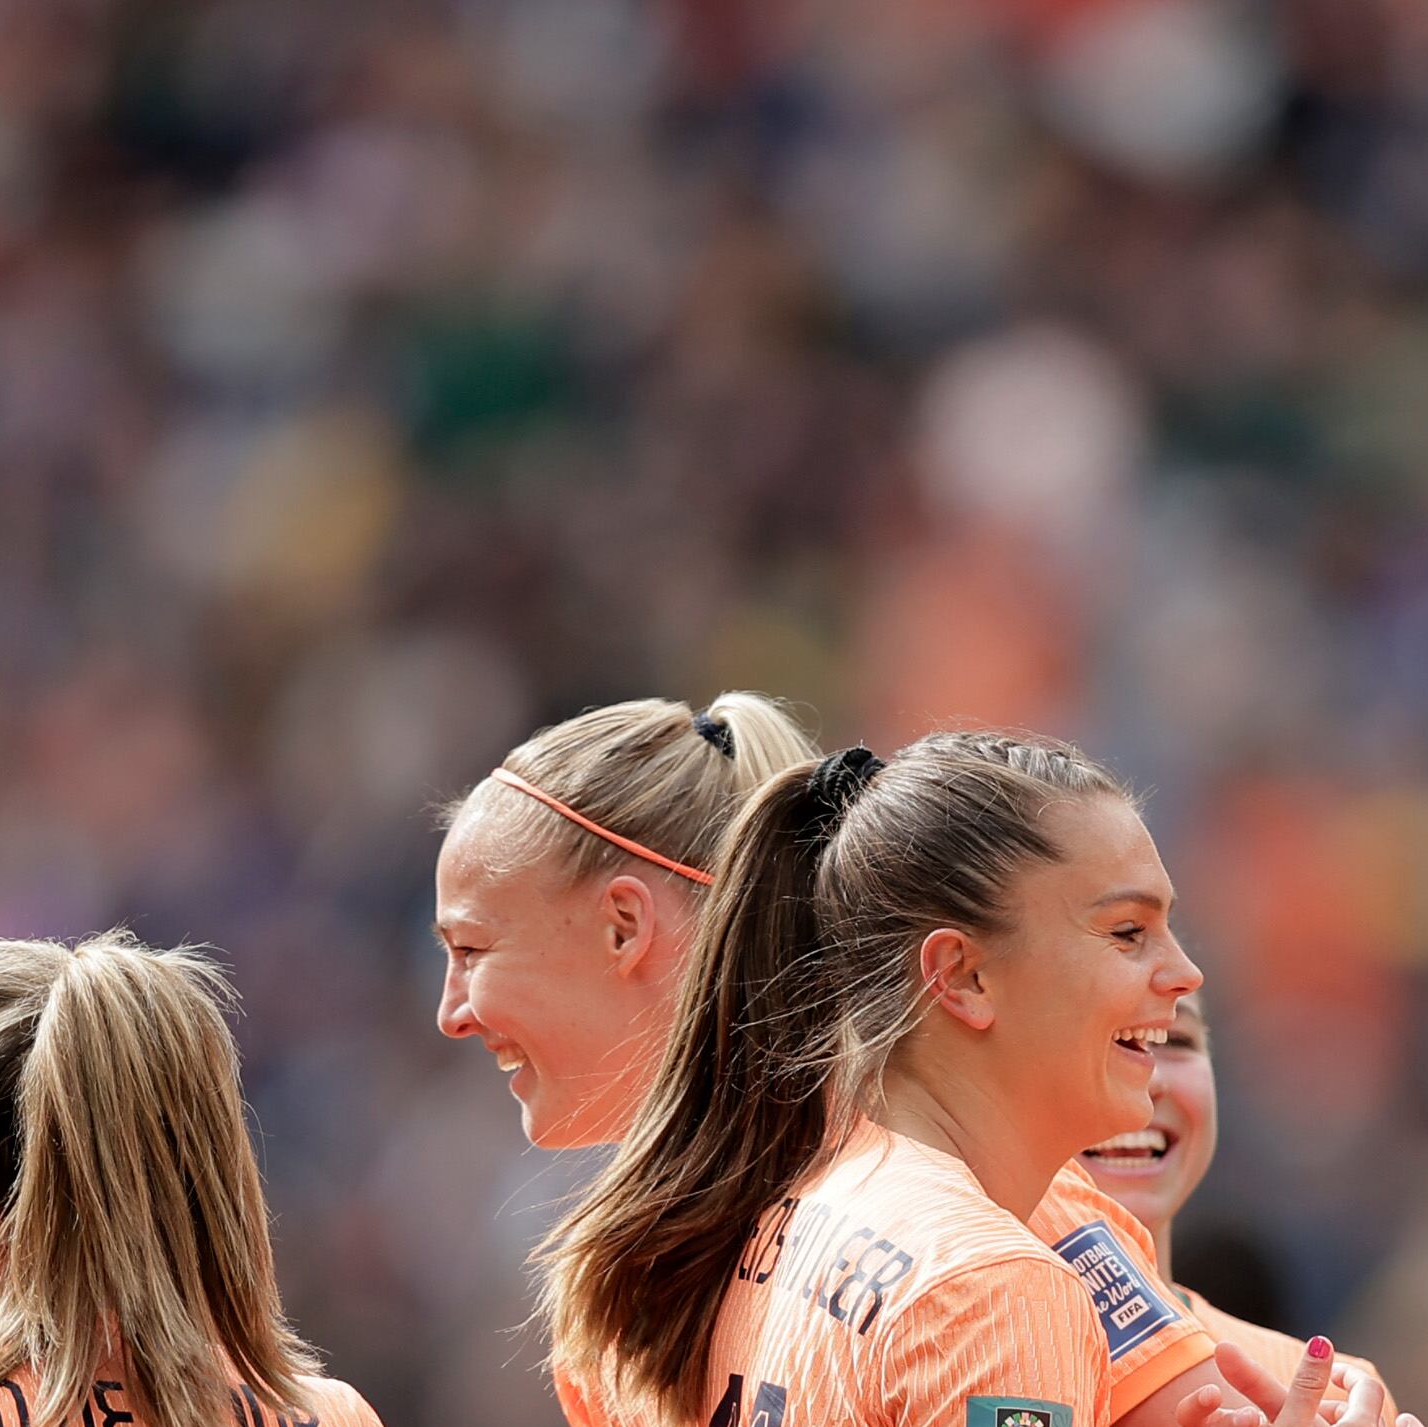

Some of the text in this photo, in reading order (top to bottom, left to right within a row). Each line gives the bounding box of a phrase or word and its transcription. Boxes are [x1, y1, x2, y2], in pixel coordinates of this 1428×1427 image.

[1073, 1241, 1114, 1273] OTBALL
[1081, 1255, 1129, 1296] NITE
[1117, 1302, 1143, 1323] FIFA
